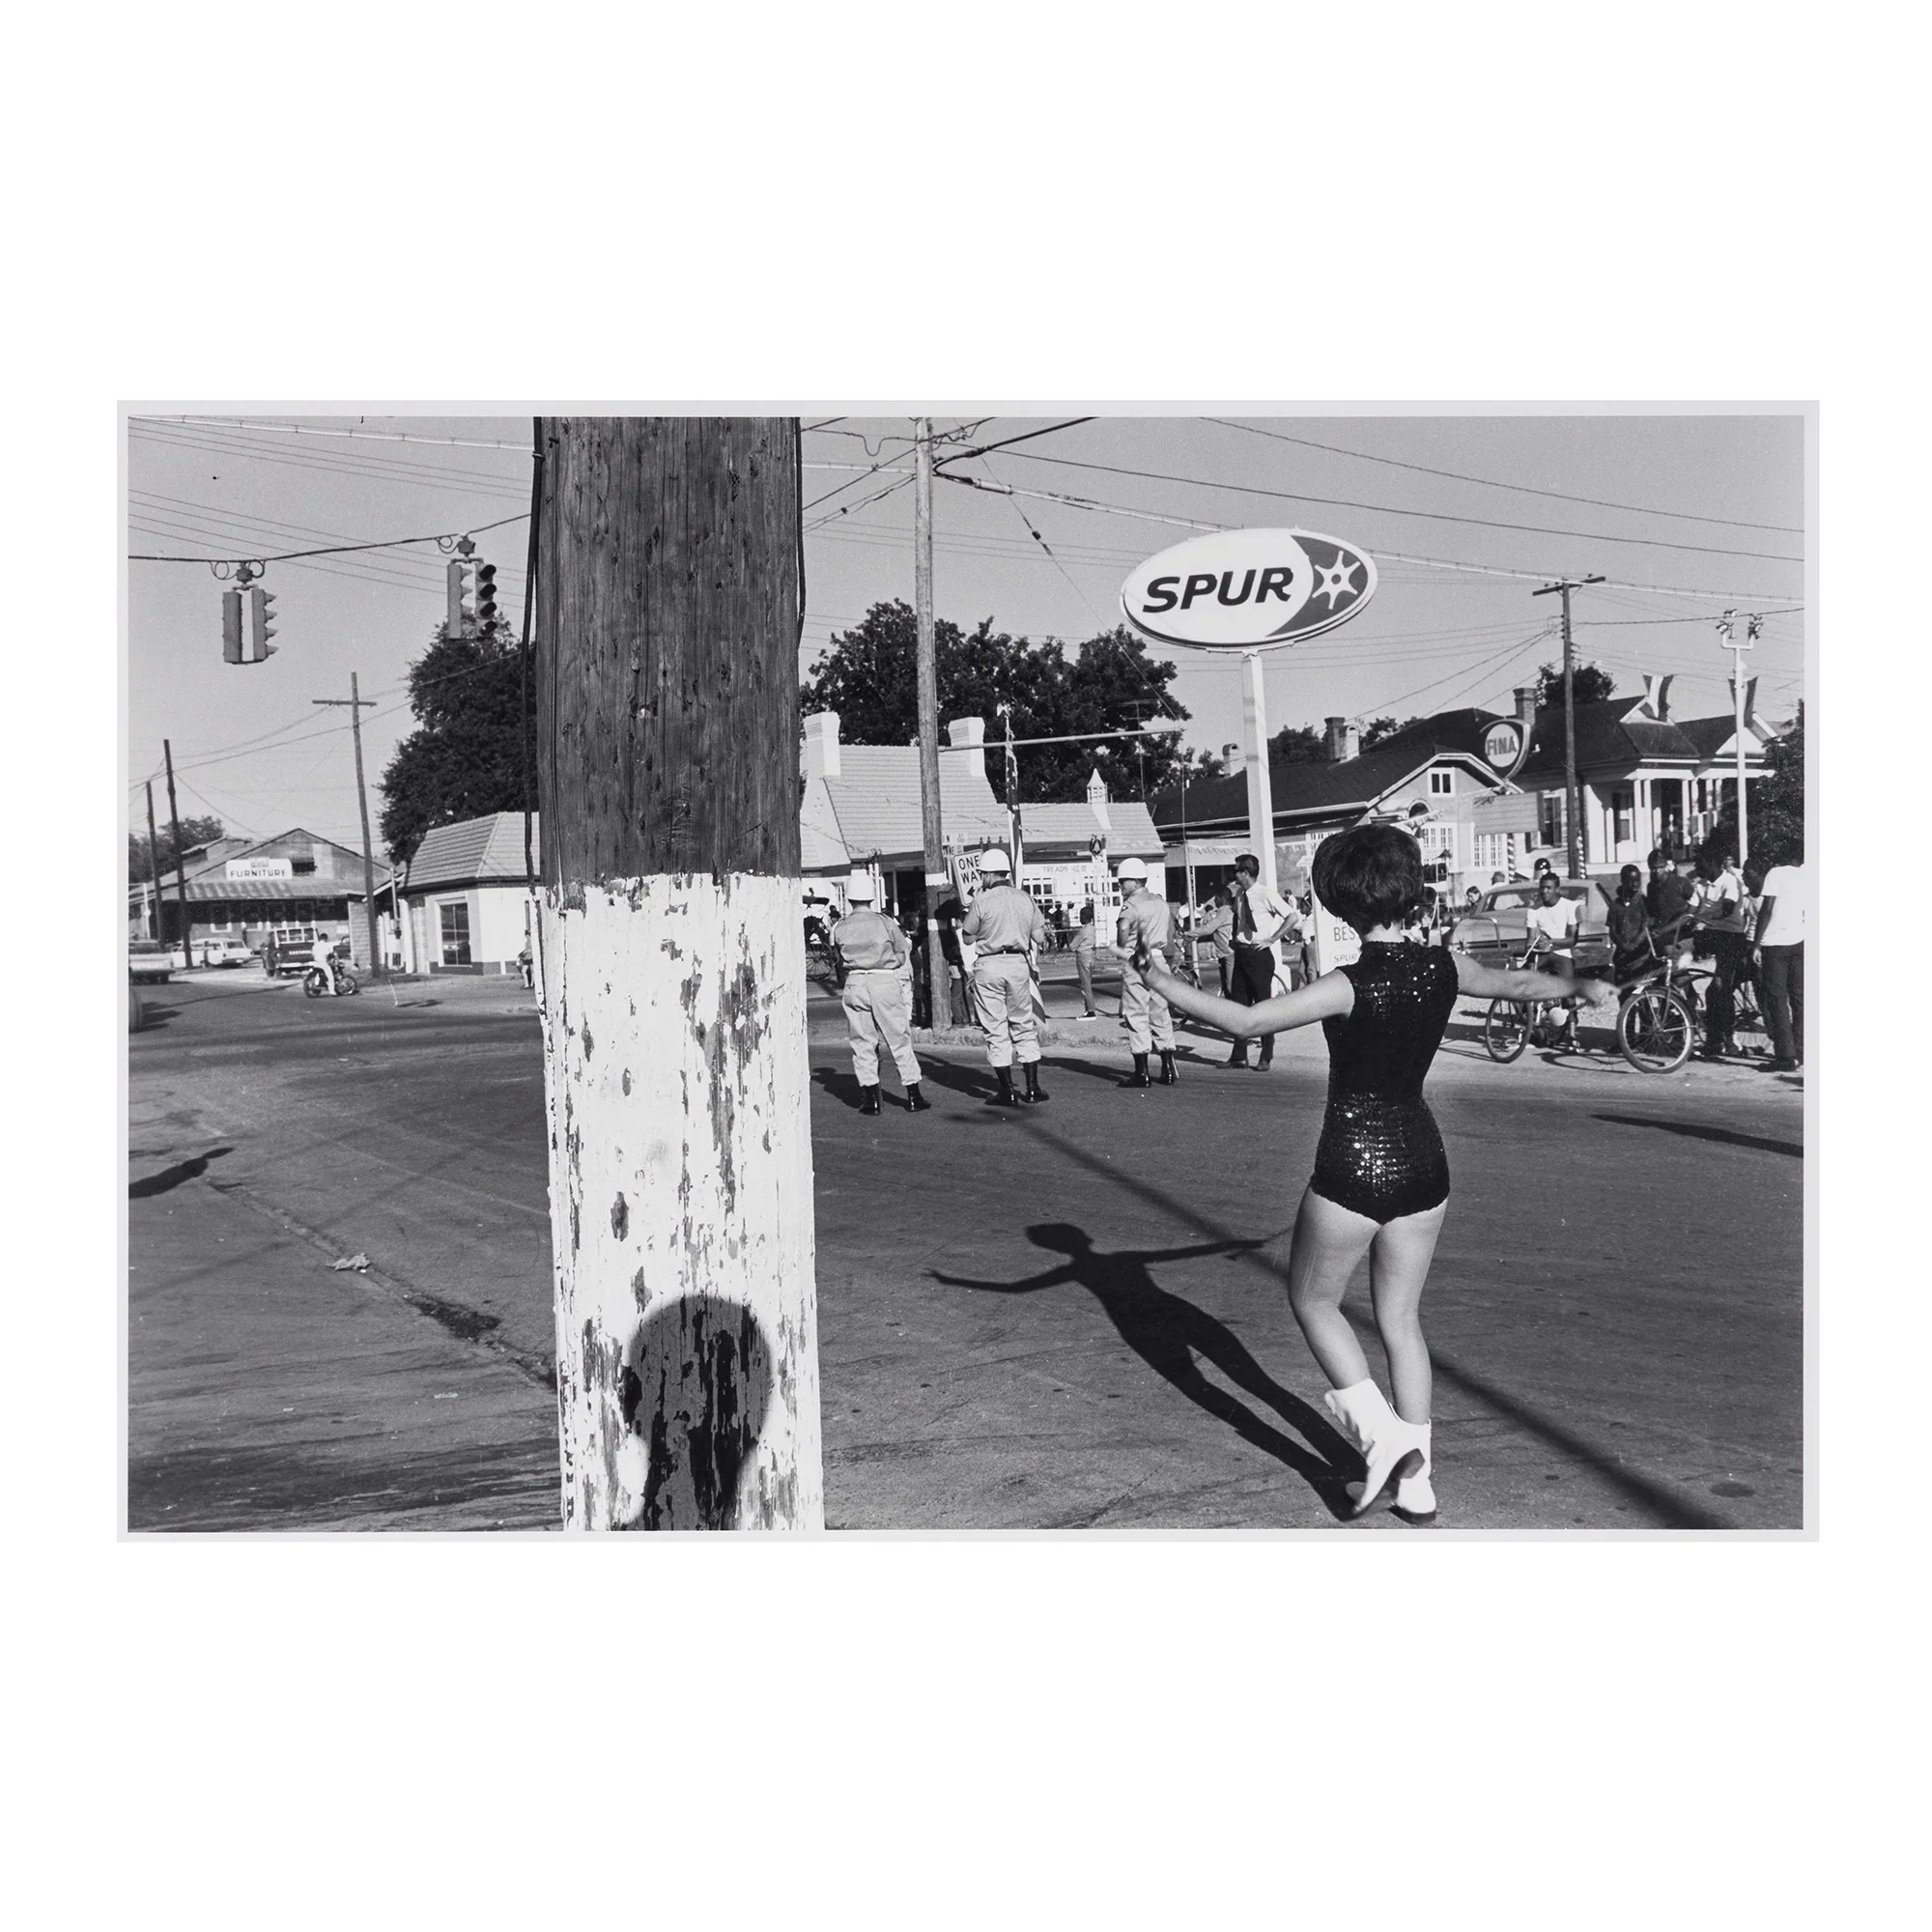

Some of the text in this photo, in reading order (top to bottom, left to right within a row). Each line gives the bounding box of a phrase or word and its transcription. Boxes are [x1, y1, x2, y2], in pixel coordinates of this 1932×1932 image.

[1143, 566, 1293, 613] SPUR
[1487, 735, 1518, 756] FINA
[958, 855, 980, 869] ONE
[961, 869, 983, 884] WAY
[1333, 926, 1356, 942] BES
[1333, 953, 1358, 963] SPUR
